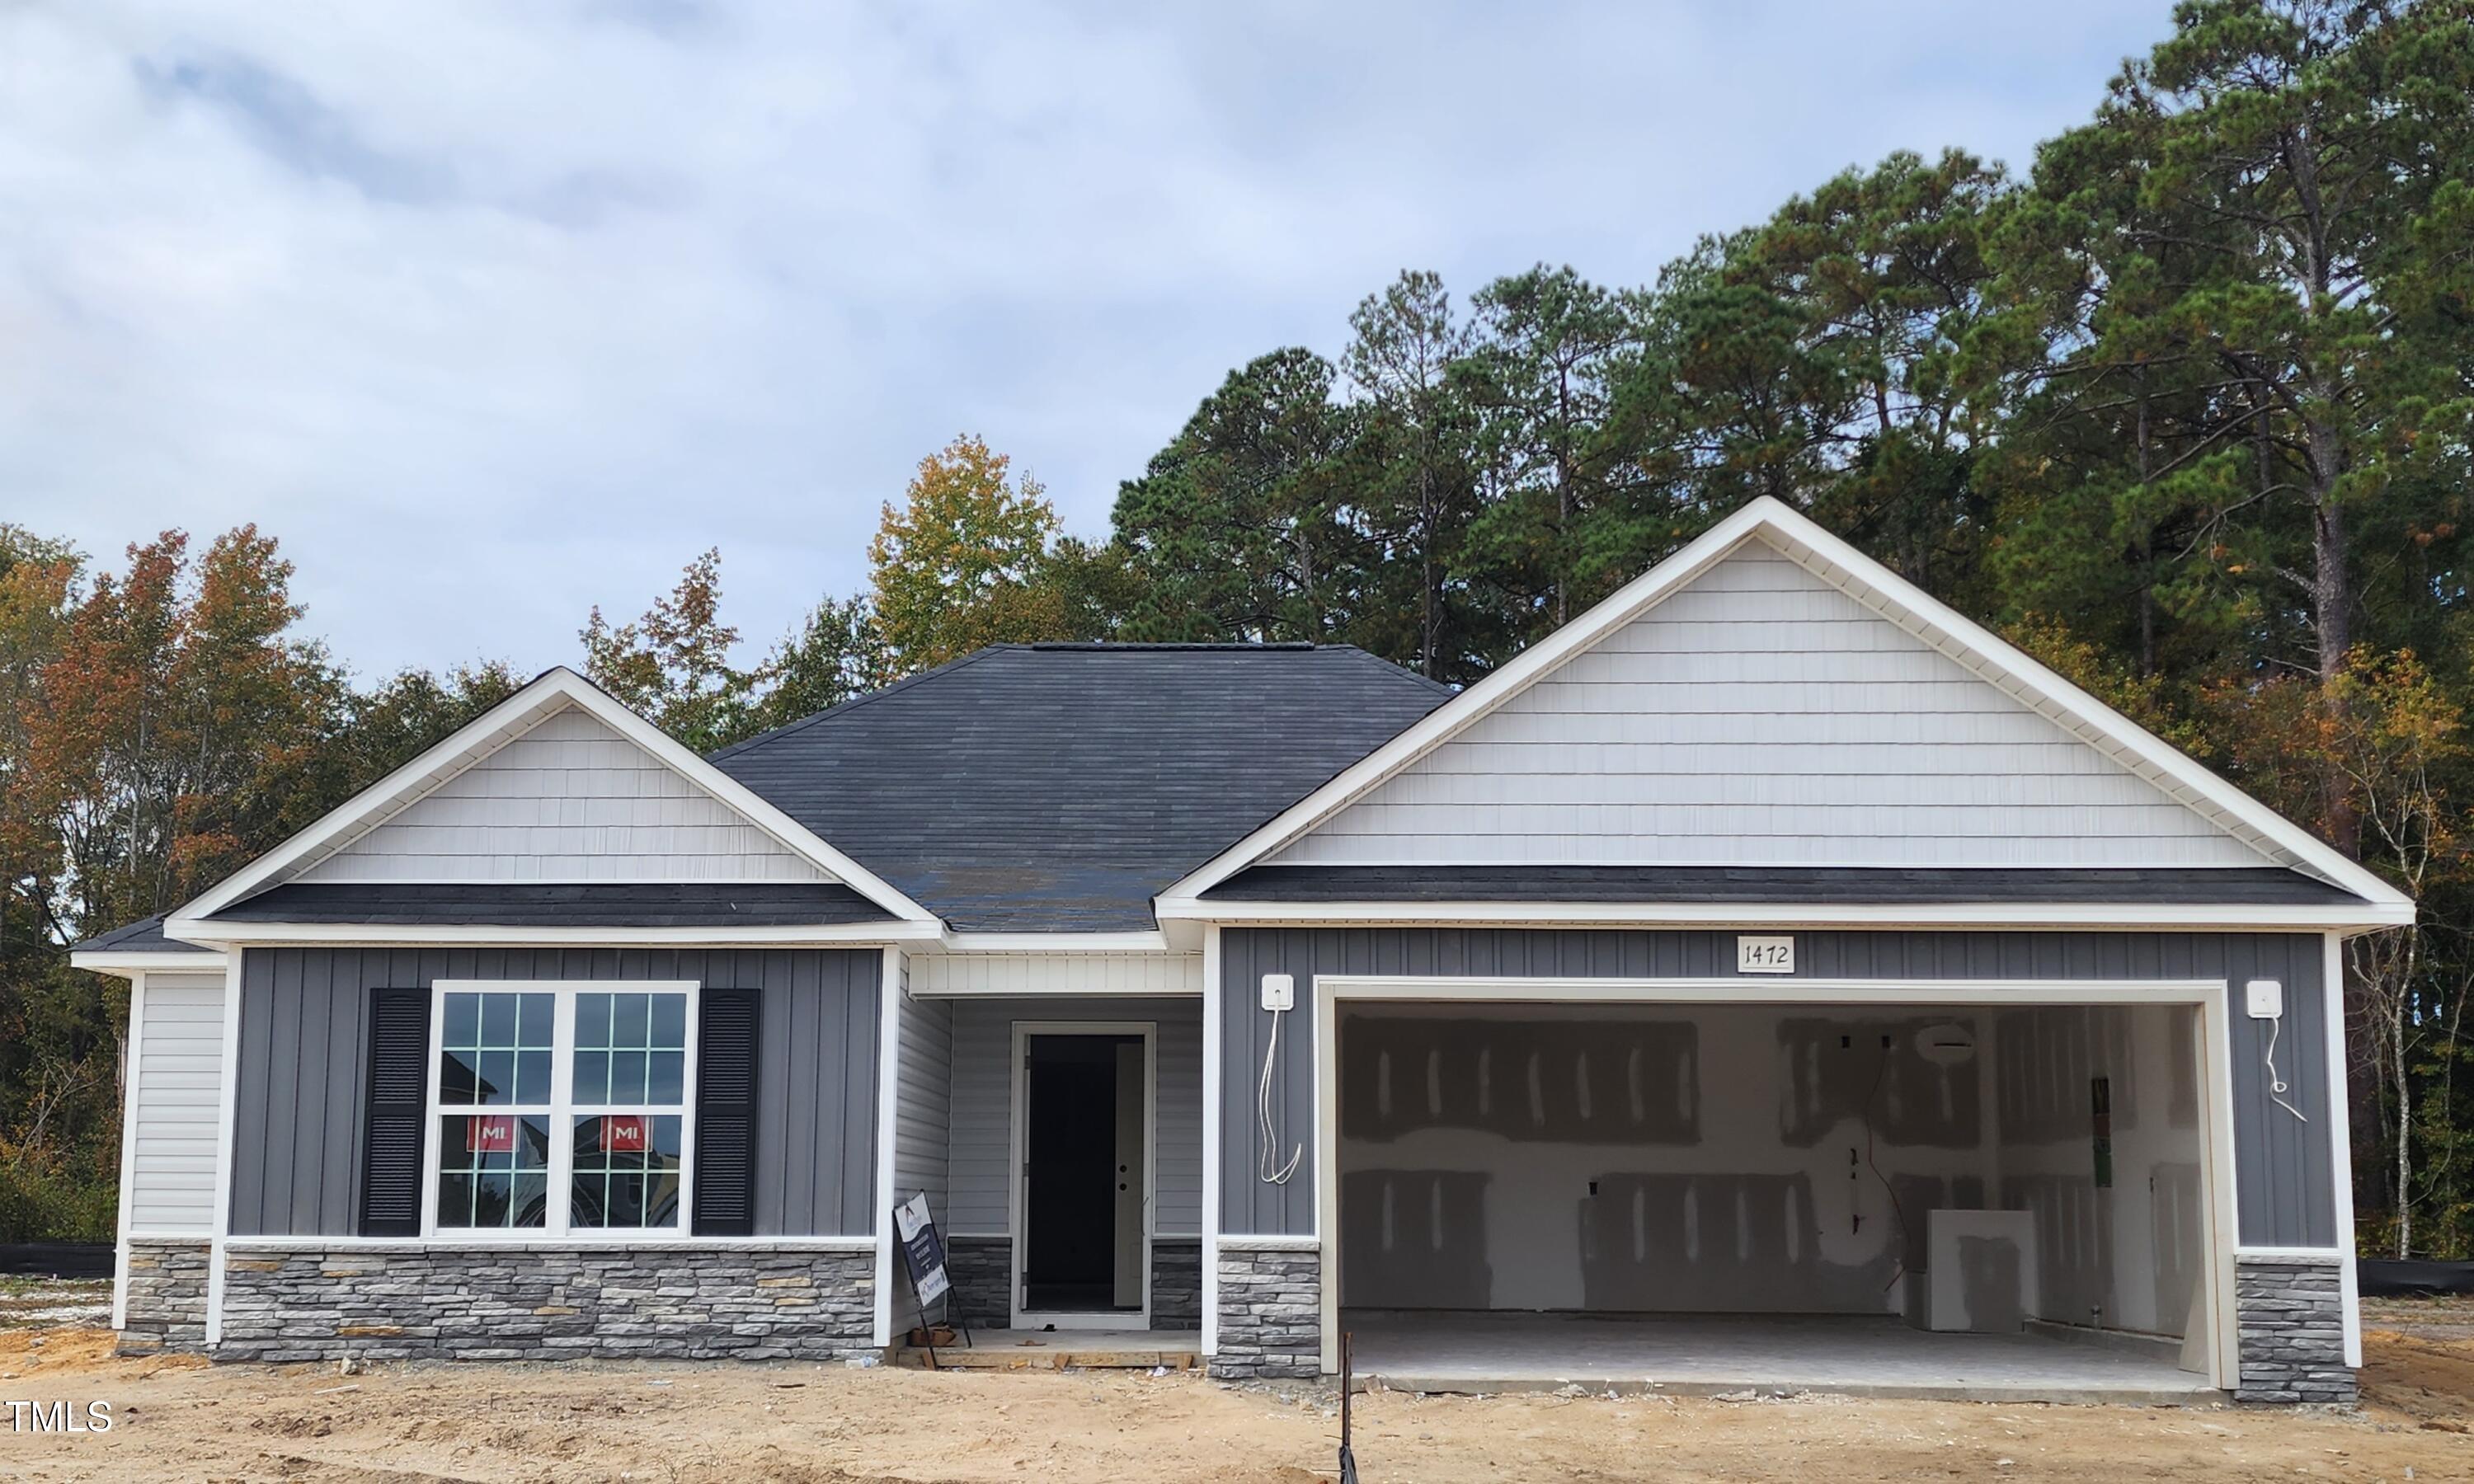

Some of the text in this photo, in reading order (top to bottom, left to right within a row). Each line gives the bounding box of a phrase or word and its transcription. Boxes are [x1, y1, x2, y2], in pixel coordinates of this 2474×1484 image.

[1745, 945, 1789, 965] 1472
[482, 1127, 505, 1139] MI
[615, 1127, 637, 1139] MI
